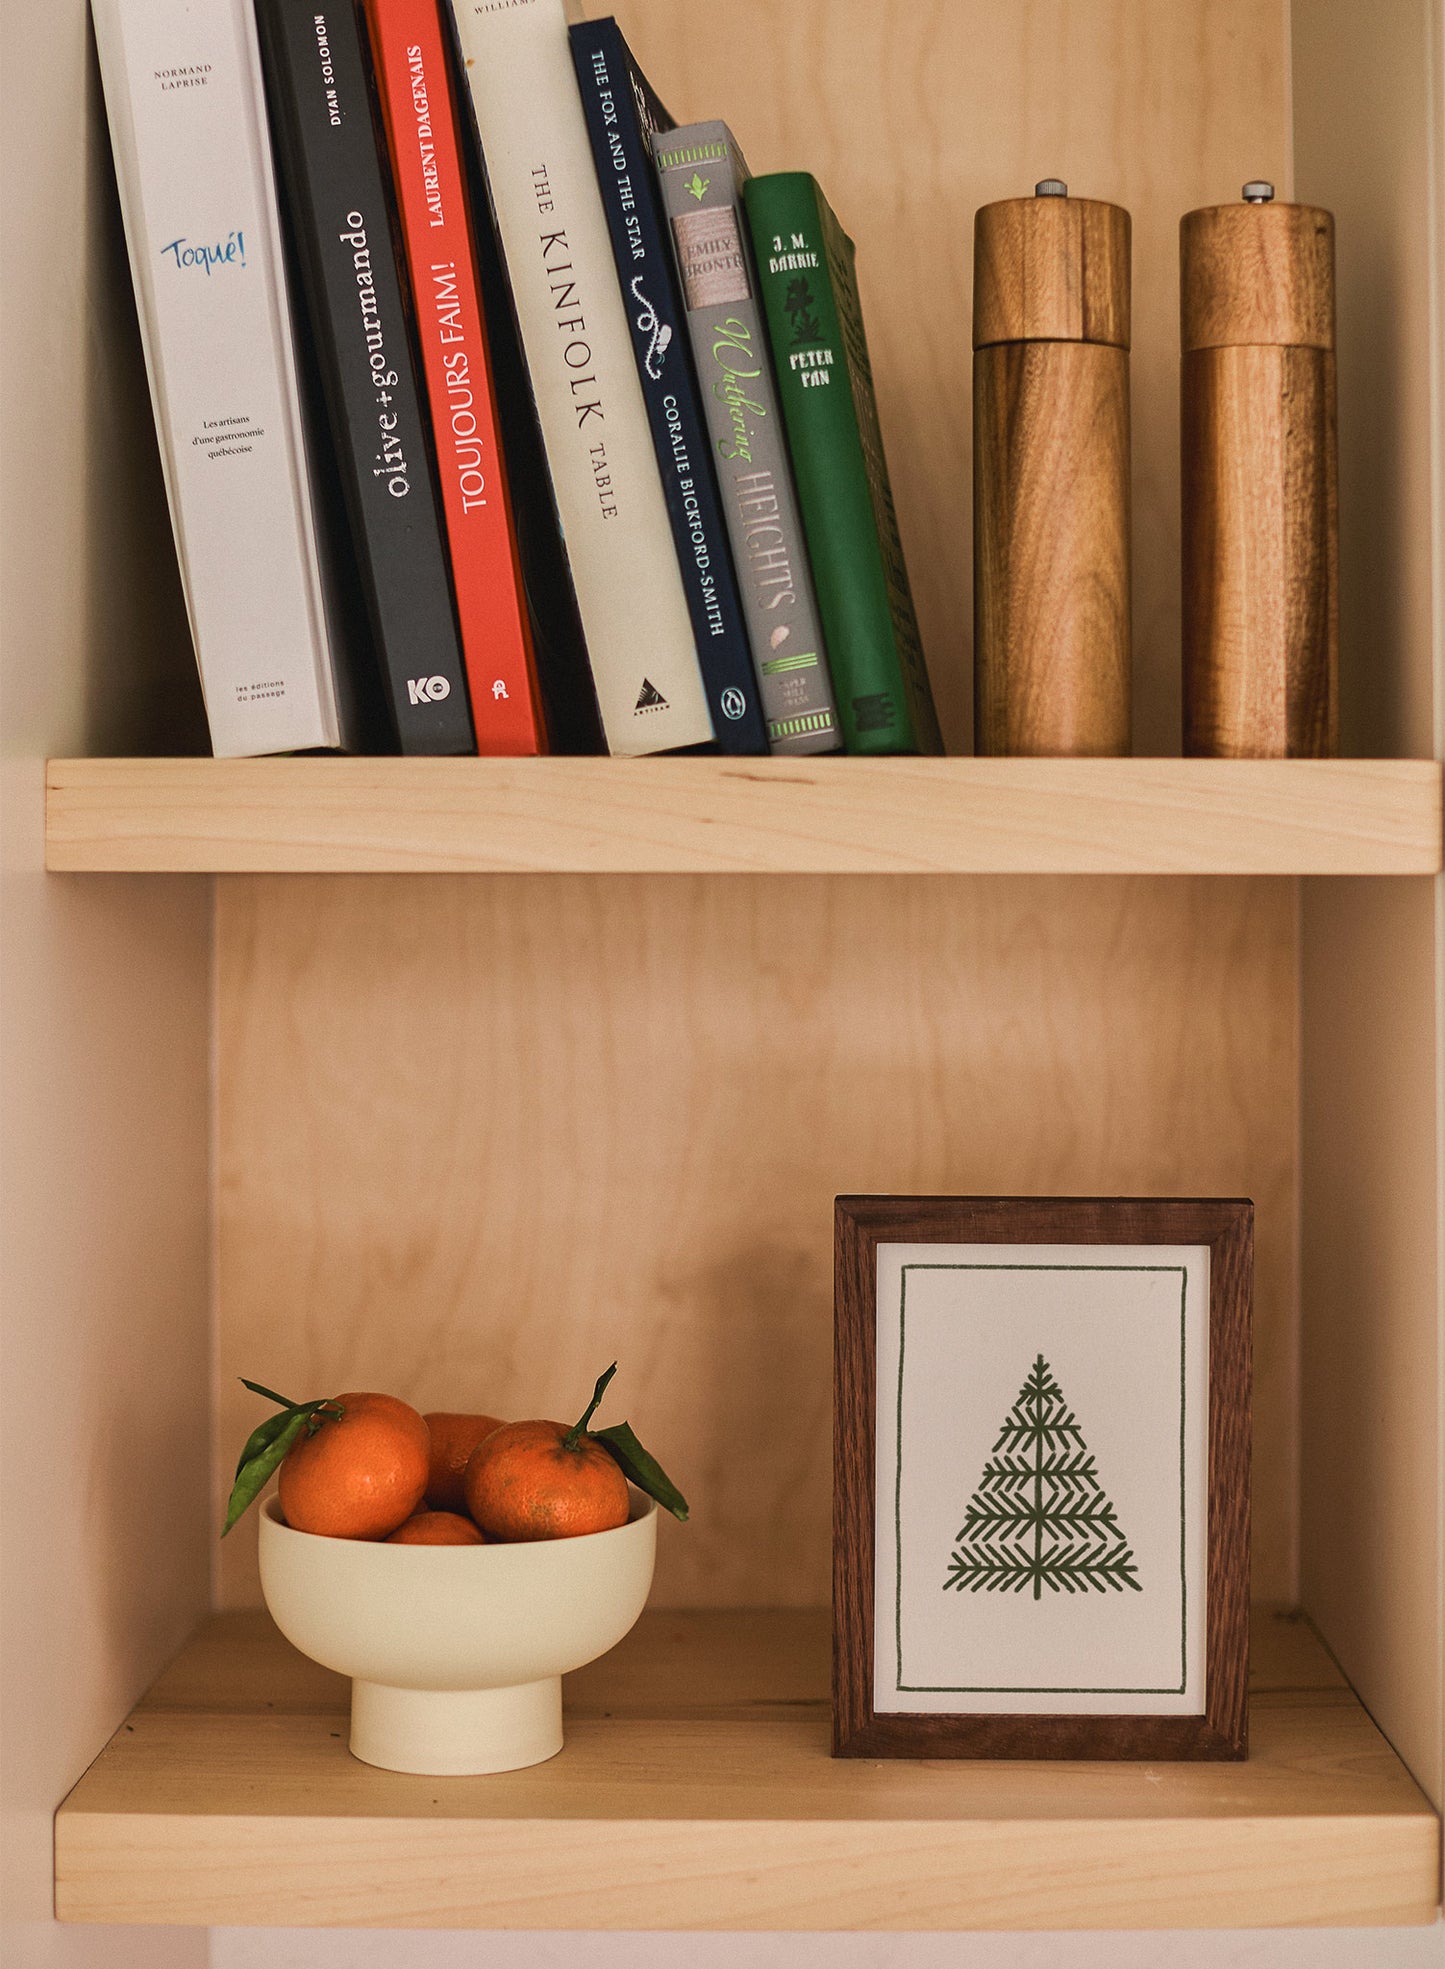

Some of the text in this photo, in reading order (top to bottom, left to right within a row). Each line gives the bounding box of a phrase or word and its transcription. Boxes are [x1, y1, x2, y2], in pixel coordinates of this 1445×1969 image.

[474, 0, 536, 15] WILLIAM
[154, 64, 213, 79] NORMAND
[161, 77, 208, 90] LAPRISE
[313, 15, 342, 127] DYAN SOLOMON
[406, 45, 445, 227] LAURENT DAGENAIS
[591, 50, 646, 261] THE FOX AND THE STAR
[160, 231, 247, 276] Toqué!
[686, 238, 733, 257] EMILY
[790, 232, 809, 250] M.
[769, 252, 819, 274] BARRIE
[340, 210, 399, 386] gourmando
[531, 164, 619, 520] THE KINFOLK TABLE
[789, 348, 834, 371] PETER
[431, 261, 487, 515] TOUJOURS FAIM!
[711, 317, 767, 464] Wuthering
[800, 369, 831, 388] PAN
[203, 416, 250, 429] Les artisans
[215, 427, 265, 444] gastronomie
[207, 445, 253, 460] québécoise
[373, 412, 412, 498] olive
[663, 394, 725, 637] CORALIE BICKFORD-SMITH
[735, 470, 795, 611] HEIGHTS
[251, 690, 285, 702] passage
[407, 675, 451, 706] KO
